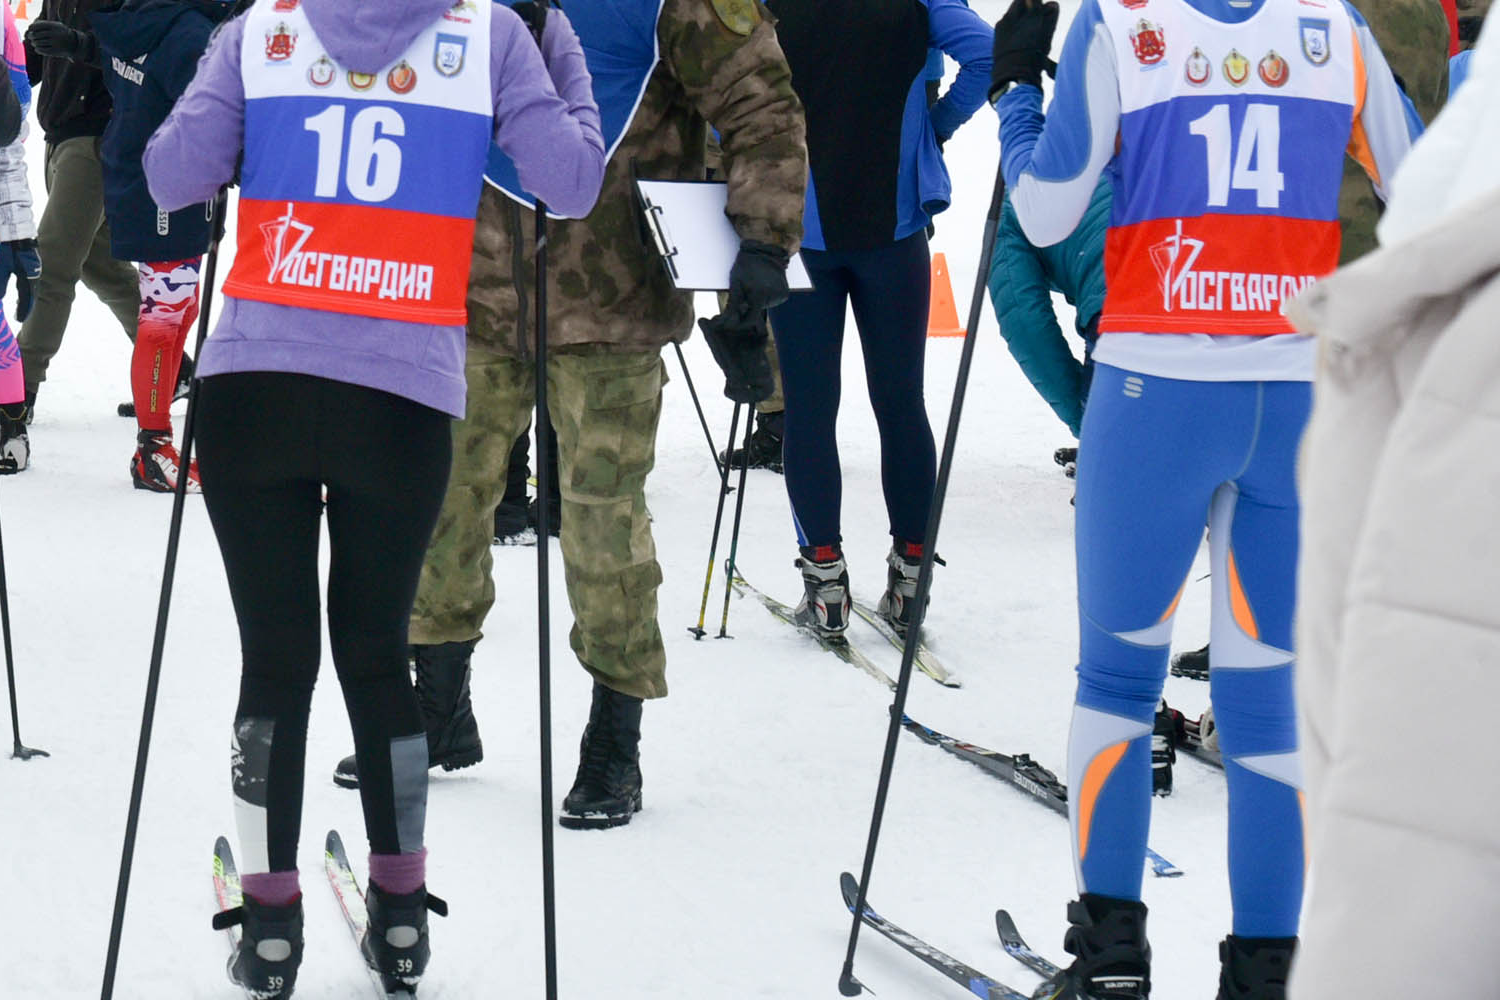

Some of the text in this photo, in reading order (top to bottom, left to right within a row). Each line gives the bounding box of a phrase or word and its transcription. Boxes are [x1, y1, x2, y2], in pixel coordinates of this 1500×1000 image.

[303, 104, 406, 203] 16
[1189, 103, 1285, 208] 14
[261, 202, 434, 301] РОСГВАРДИЯ
[267, 975, 284, 990] 39
[397, 959, 413, 973] 39
